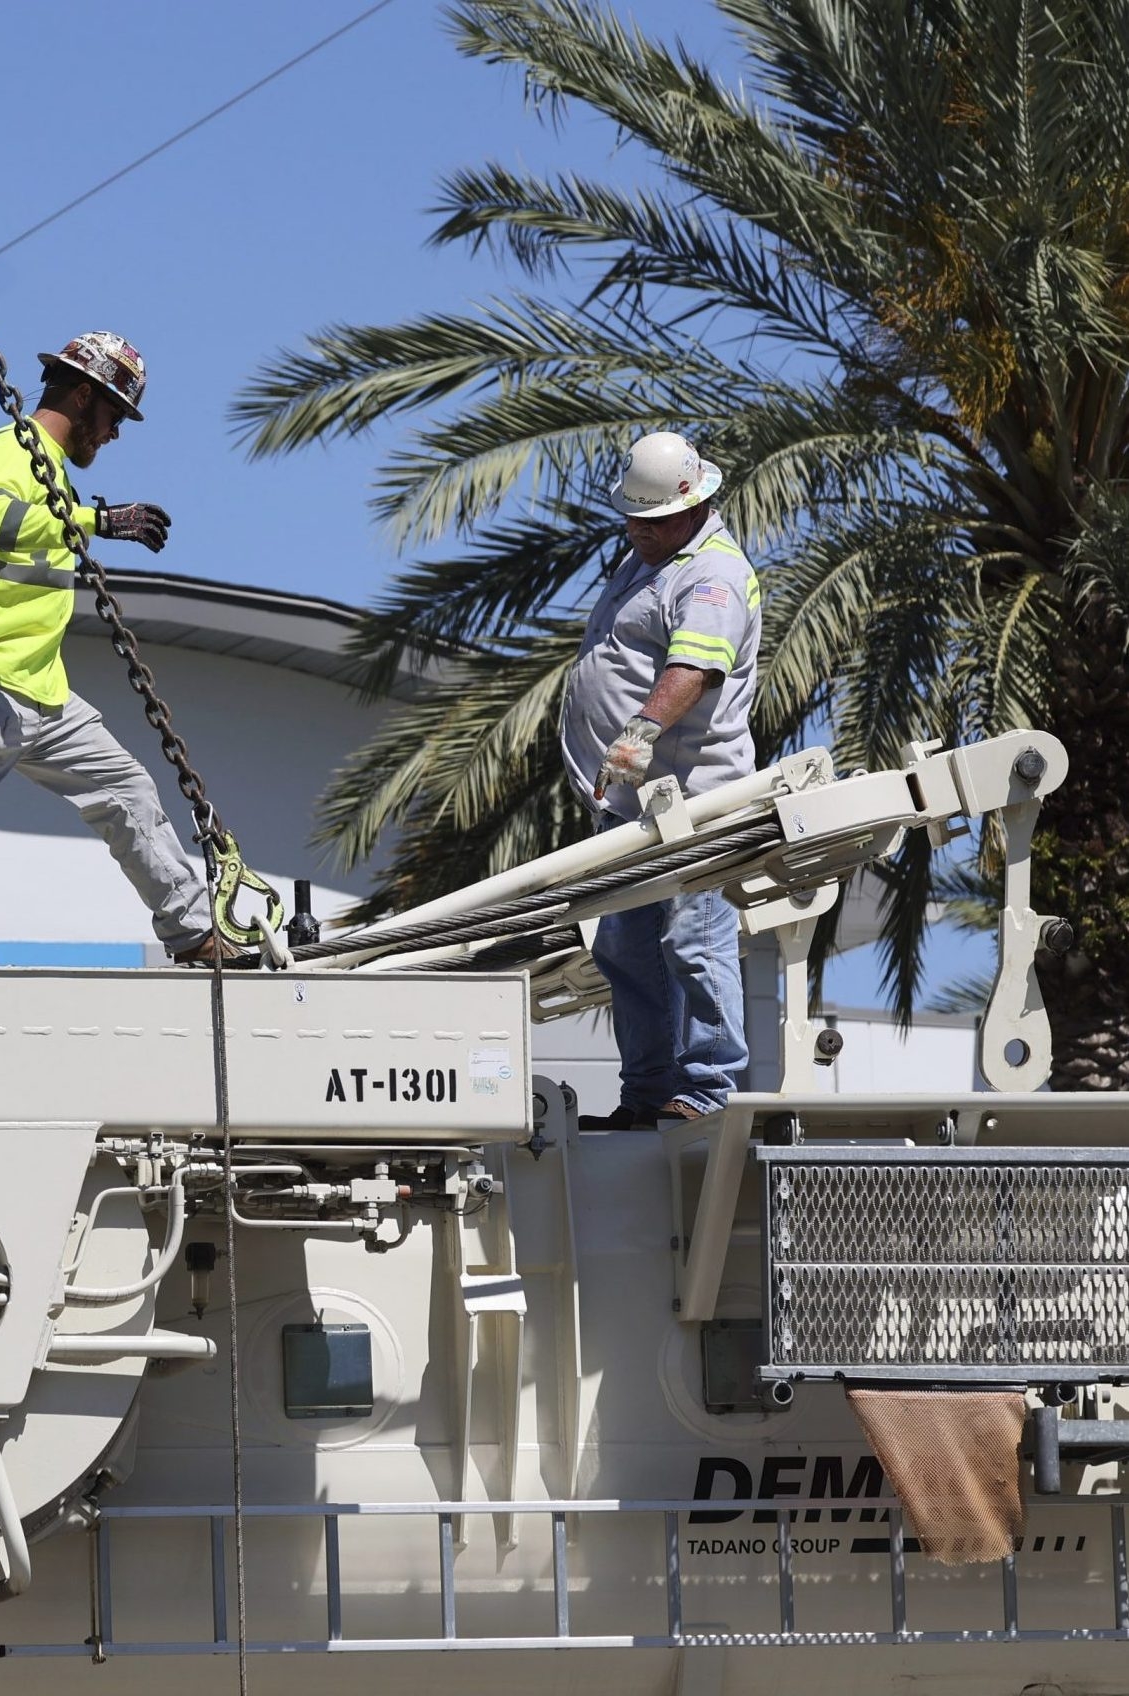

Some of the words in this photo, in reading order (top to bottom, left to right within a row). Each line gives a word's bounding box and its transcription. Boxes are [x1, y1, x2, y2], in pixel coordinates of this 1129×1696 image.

[325, 1068, 458, 1103] AT-1301
[688, 1456, 900, 1524] DEM
[687, 1539, 766, 1555] TADANO
